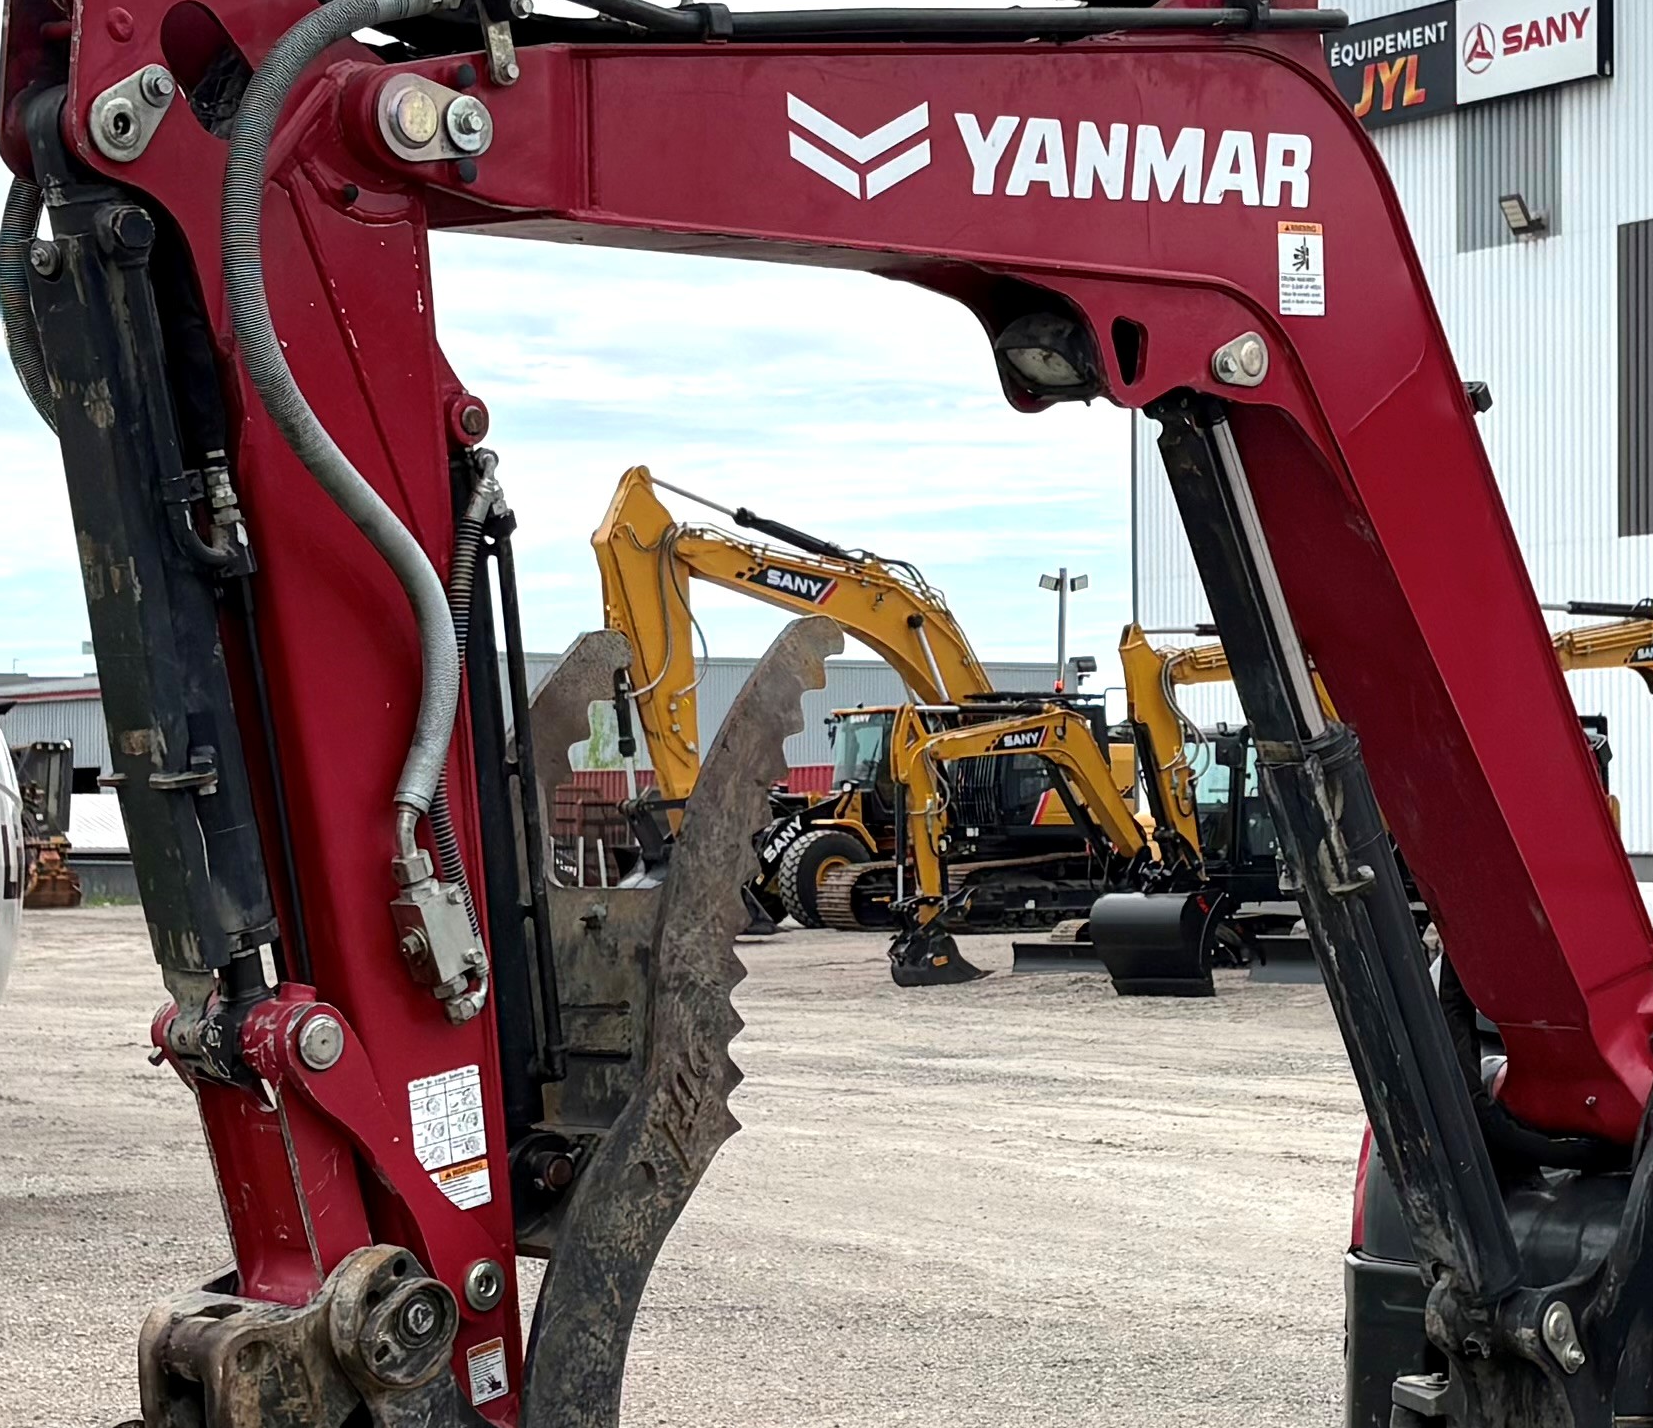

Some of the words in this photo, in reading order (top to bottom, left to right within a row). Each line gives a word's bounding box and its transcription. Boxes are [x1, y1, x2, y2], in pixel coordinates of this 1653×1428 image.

[1330, 21, 1448, 67] ÉQUIPEMENT
[1502, 6, 1590, 56] SANY
[1354, 54, 1426, 119] JYL
[953, 112, 1313, 209] YANMAR
[766, 568, 823, 597] SANY
[1003, 731, 1039, 747] SANY
[763, 815, 803, 863] SANY
